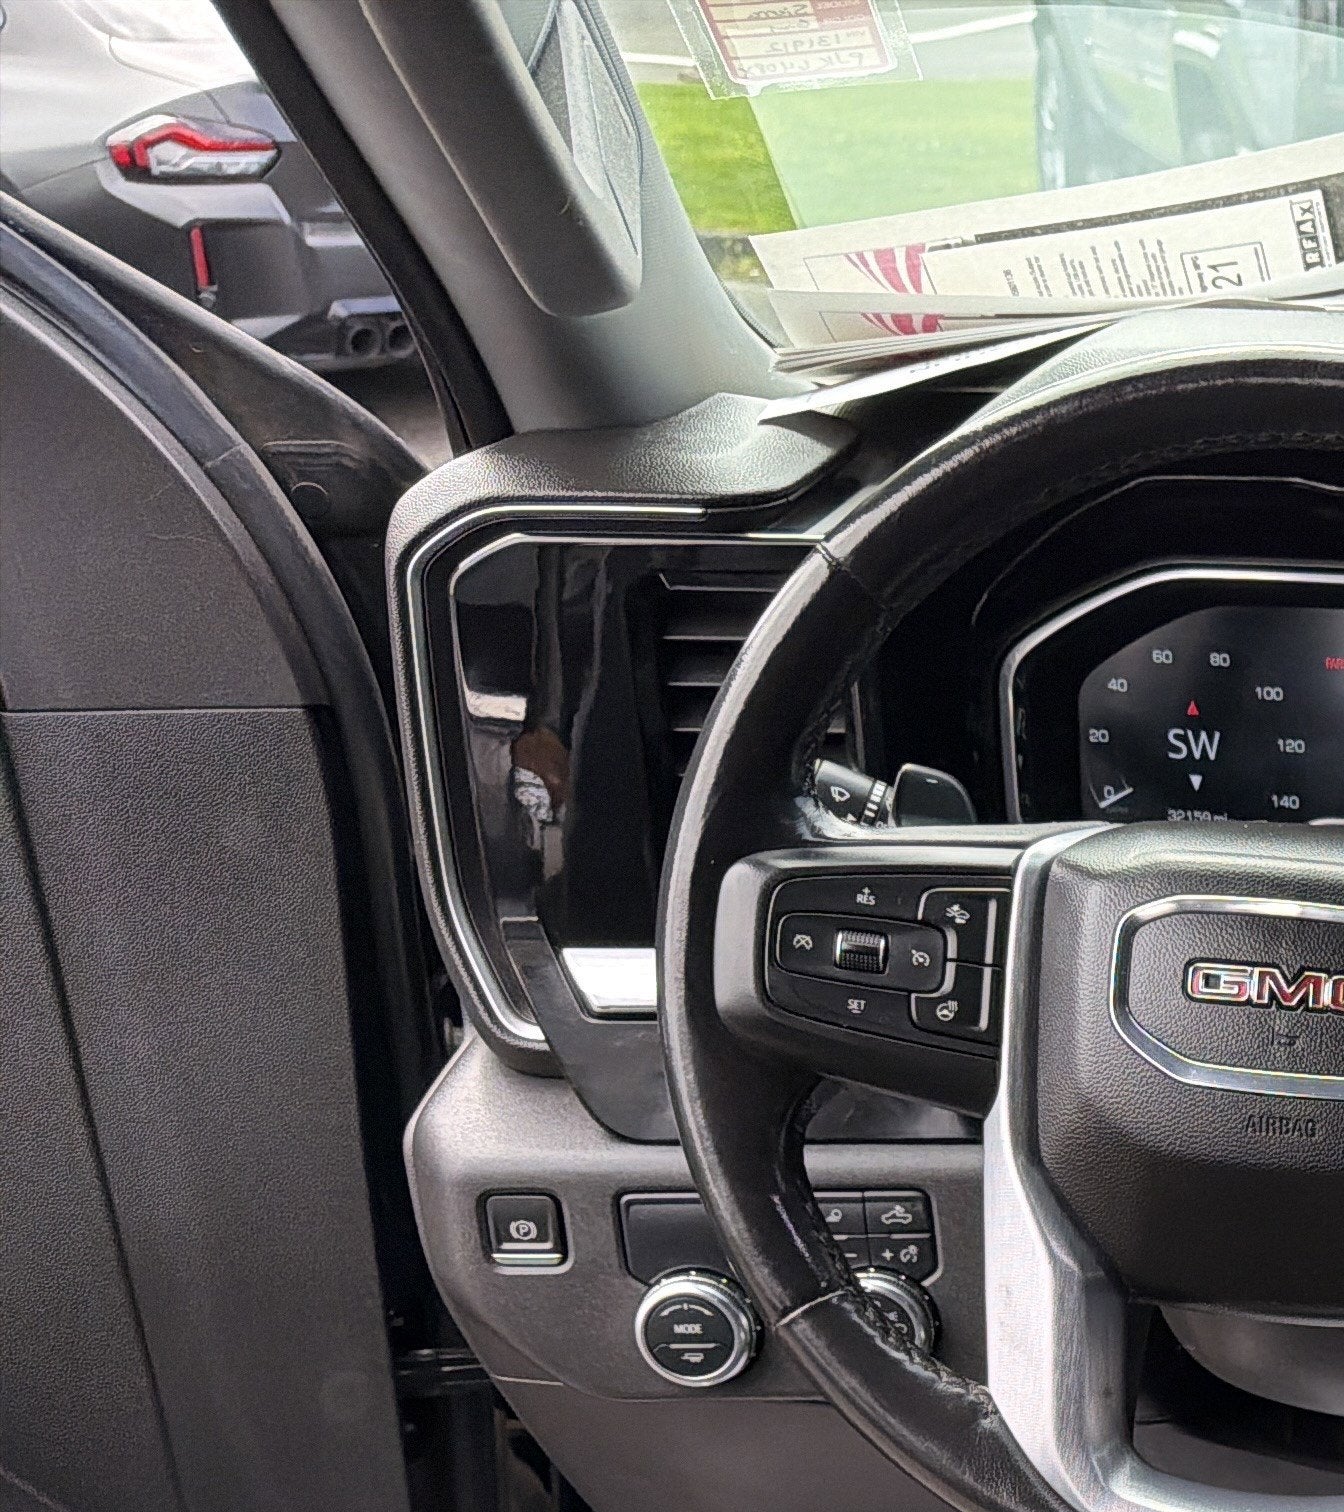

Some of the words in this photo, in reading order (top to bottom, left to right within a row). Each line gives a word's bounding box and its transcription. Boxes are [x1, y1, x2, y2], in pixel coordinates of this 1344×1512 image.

[1211, 261, 1243, 290] 21
[1152, 650, 1173, 664] 60
[1209, 653, 1231, 667] 80
[1107, 678, 1128, 692] 40
[1255, 686, 1284, 701] 100
[1088, 728, 1109, 743] 20
[1167, 728, 1221, 760] SW
[1277, 738, 1306, 753] 120
[1271, 795, 1300, 810] 140
[856, 893, 876, 906] RES
[847, 998, 867, 1012] SET
[1242, 1113, 1320, 1139] AIRBAG
[673, 1323, 704, 1335] MODE
